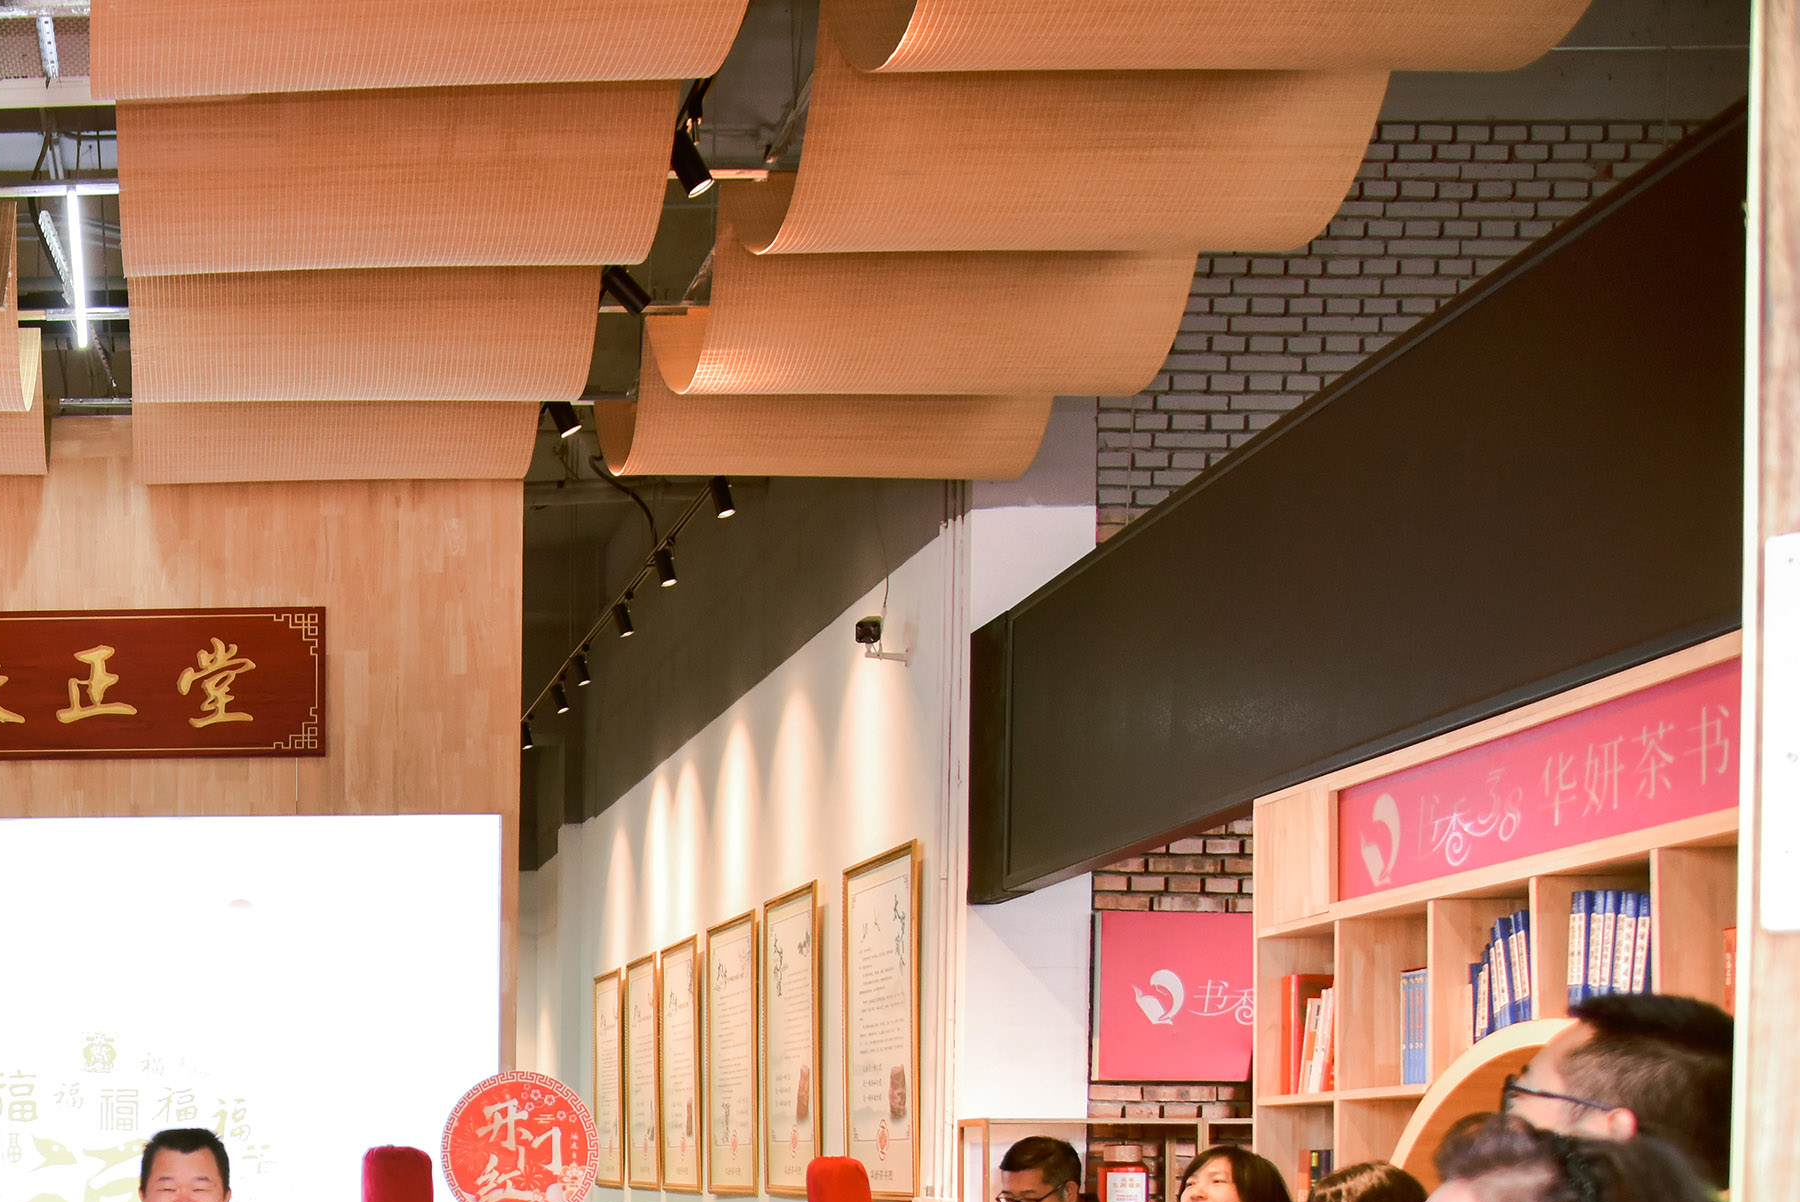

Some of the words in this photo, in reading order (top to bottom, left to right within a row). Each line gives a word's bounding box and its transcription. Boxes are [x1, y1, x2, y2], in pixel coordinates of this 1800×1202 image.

[1541, 705, 1731, 826] 华妍茶书
[53, 1081, 84, 1111] 福
[152, 1086, 198, 1124] 福
[211, 1098, 252, 1142] 福
